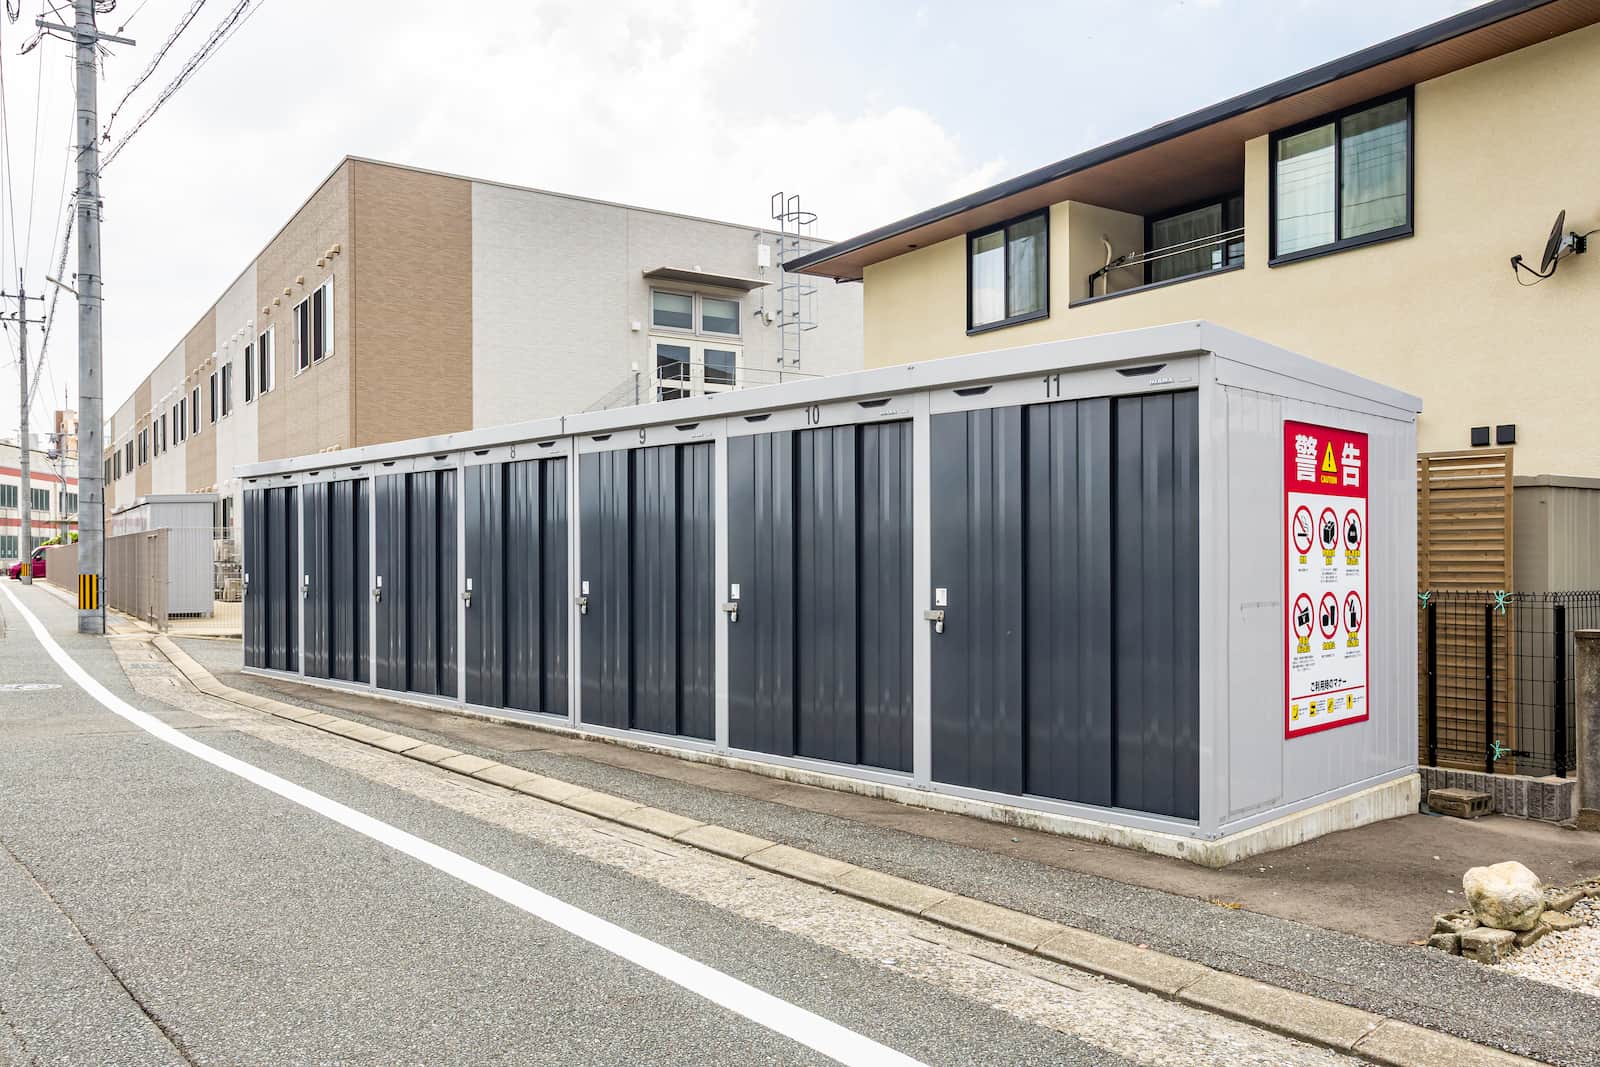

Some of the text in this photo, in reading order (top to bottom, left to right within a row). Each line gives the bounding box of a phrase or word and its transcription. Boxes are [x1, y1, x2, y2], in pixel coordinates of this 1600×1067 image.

[1043, 373, 1060, 398] 11
[805, 404, 820, 425] 10
[639, 427, 646, 444] 9
[510, 445, 516, 459] 8
[1295, 434, 1361, 488] 警告
